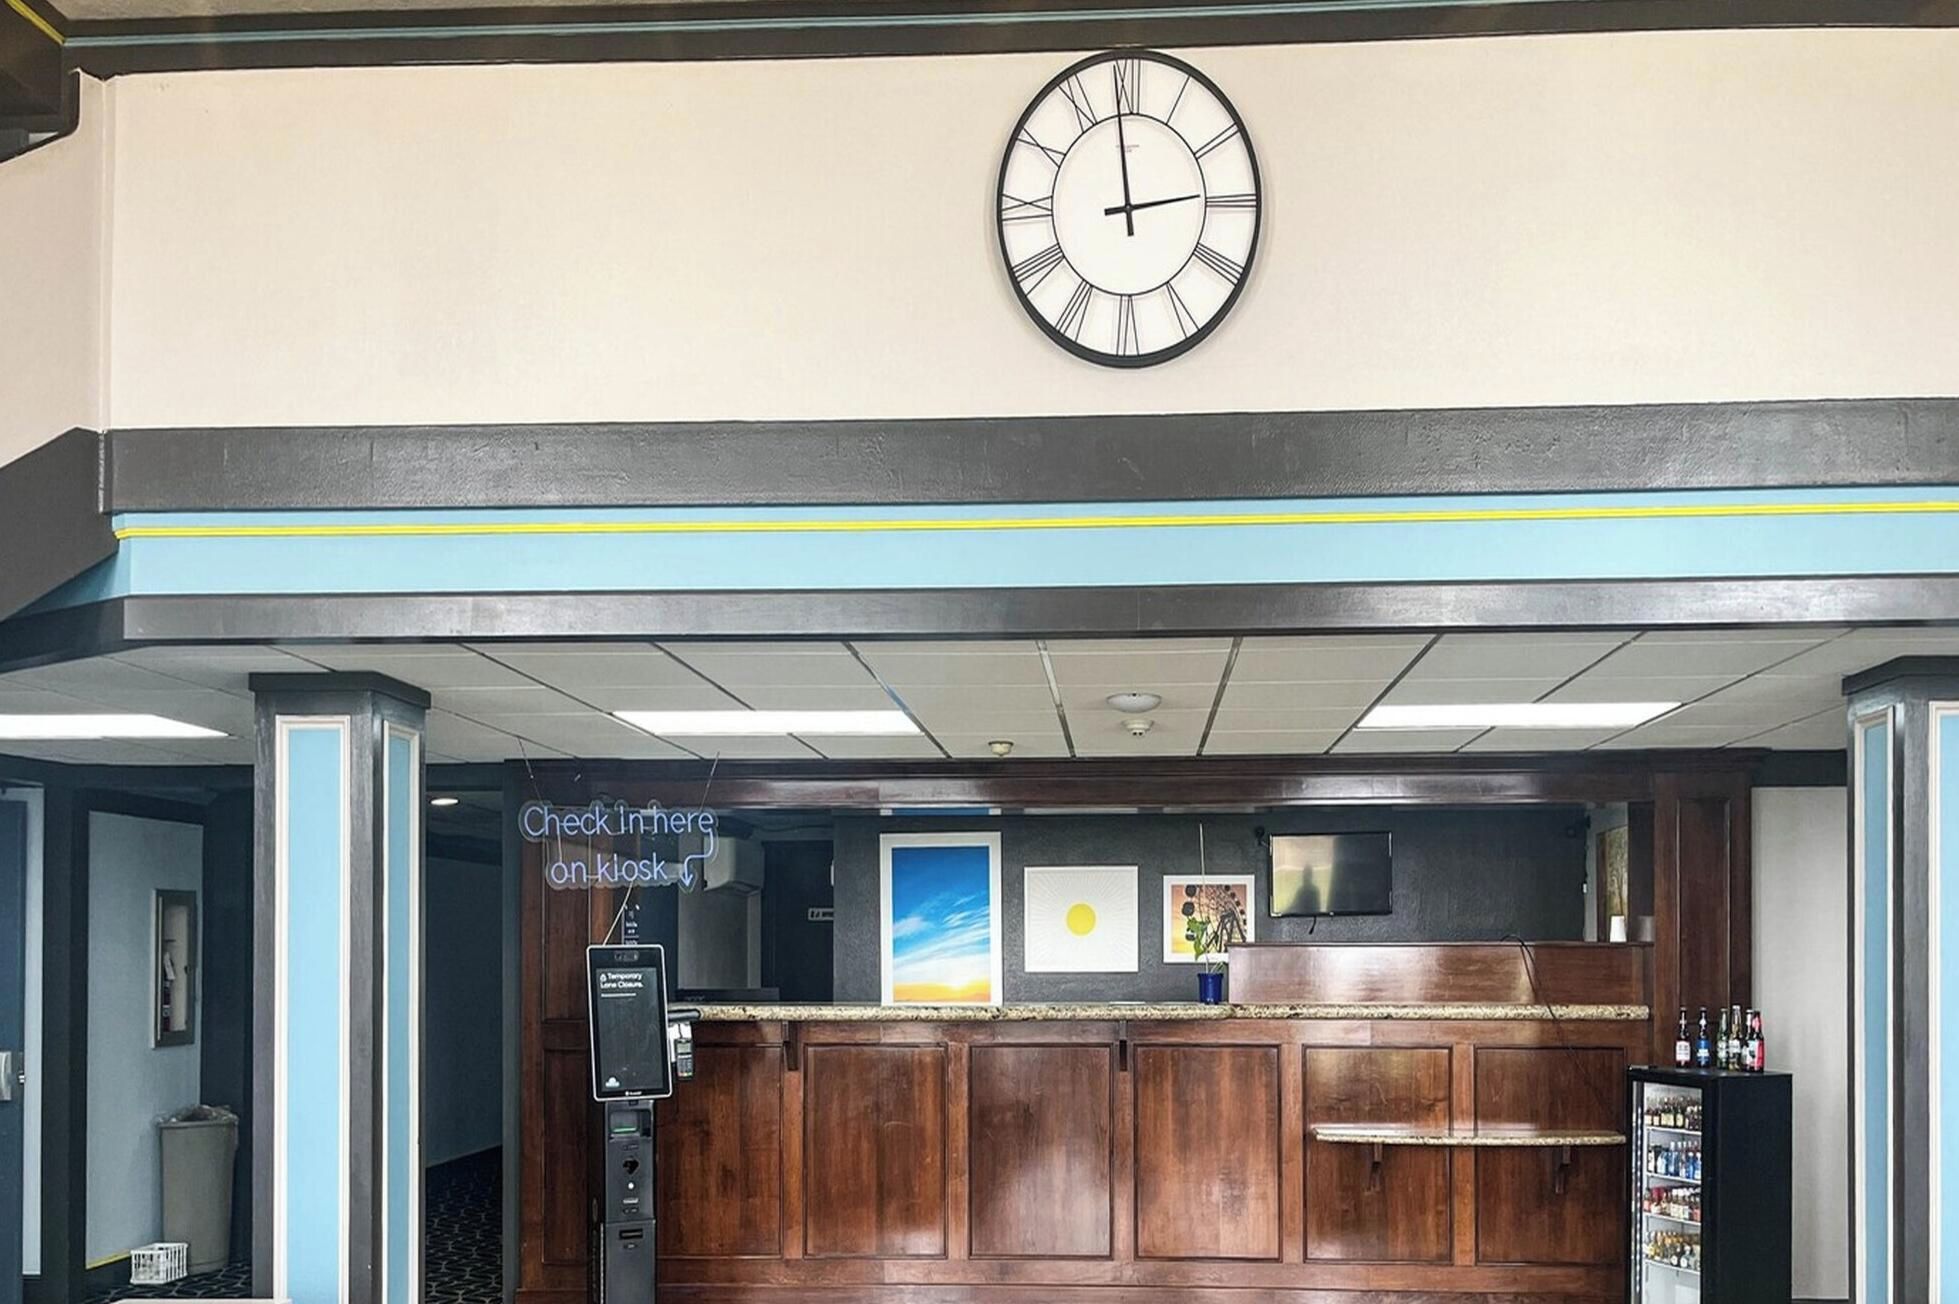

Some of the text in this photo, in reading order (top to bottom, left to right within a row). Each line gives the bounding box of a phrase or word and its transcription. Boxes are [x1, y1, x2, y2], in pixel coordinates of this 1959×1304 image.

[1057, 73, 1098, 133] XI
[1016, 127, 1066, 168] X
[1194, 122, 1240, 160] II
[1002, 193, 1053, 221] IX
[1205, 193, 1257, 208] III
[524, 805, 714, 836] Check in here
[550, 853, 668, 883] on kiosk
